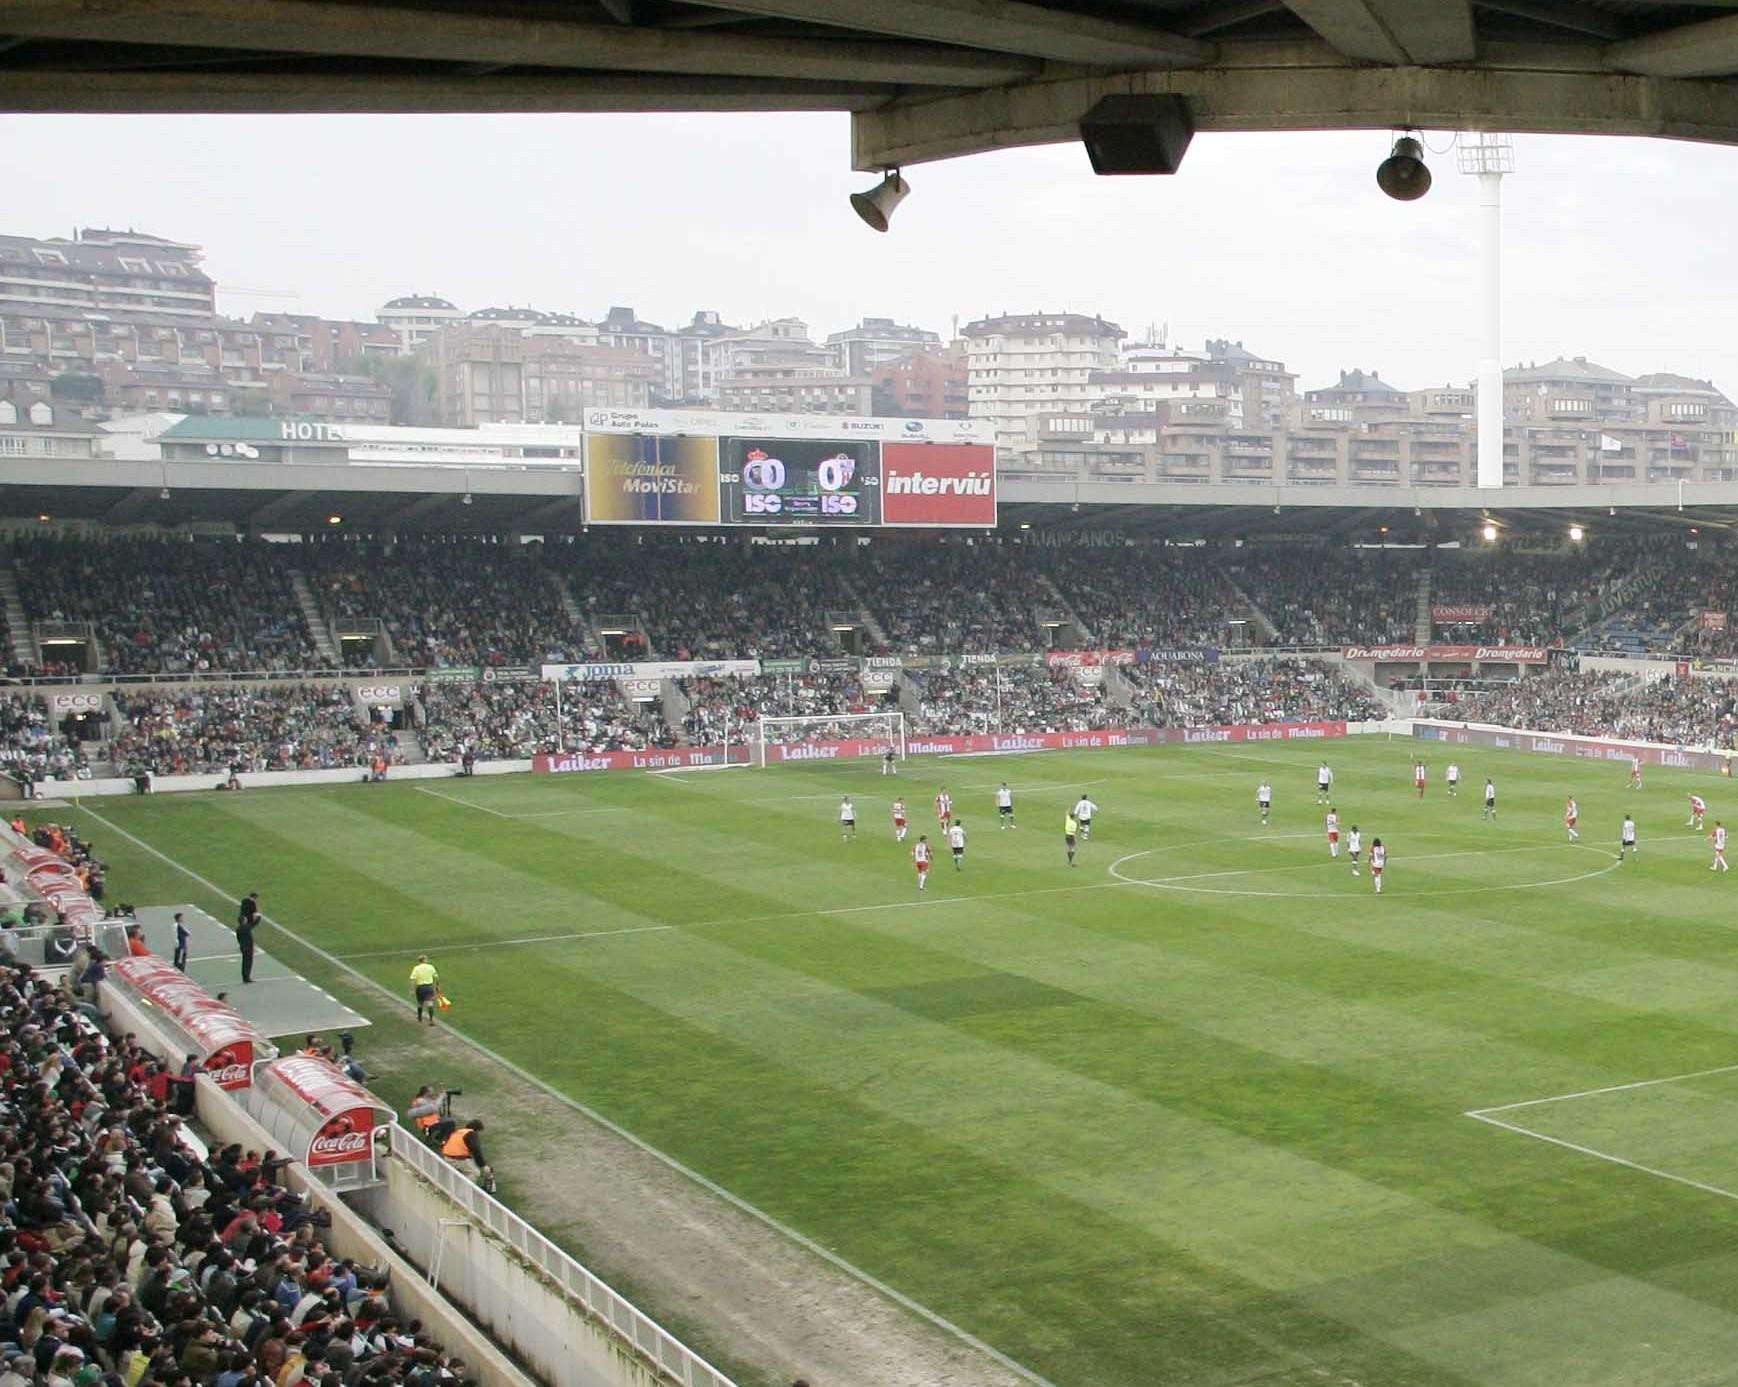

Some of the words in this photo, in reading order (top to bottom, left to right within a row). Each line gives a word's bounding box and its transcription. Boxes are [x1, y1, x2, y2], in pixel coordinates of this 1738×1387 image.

[887, 470, 991, 496] interviú
[1150, 652, 1204, 661] AQUABONA
[1346, 647, 1425, 659] Dromedario
[1475, 647, 1543, 660] Dromedario
[781, 744, 839, 760] Laiker
[872, 745, 888, 756] si
[909, 742, 953, 753] Mahou
[547, 754, 612, 773] Laiker
[634, 755, 646, 768] La
[650, 756, 665, 767] sin
[668, 753, 680, 765] de
